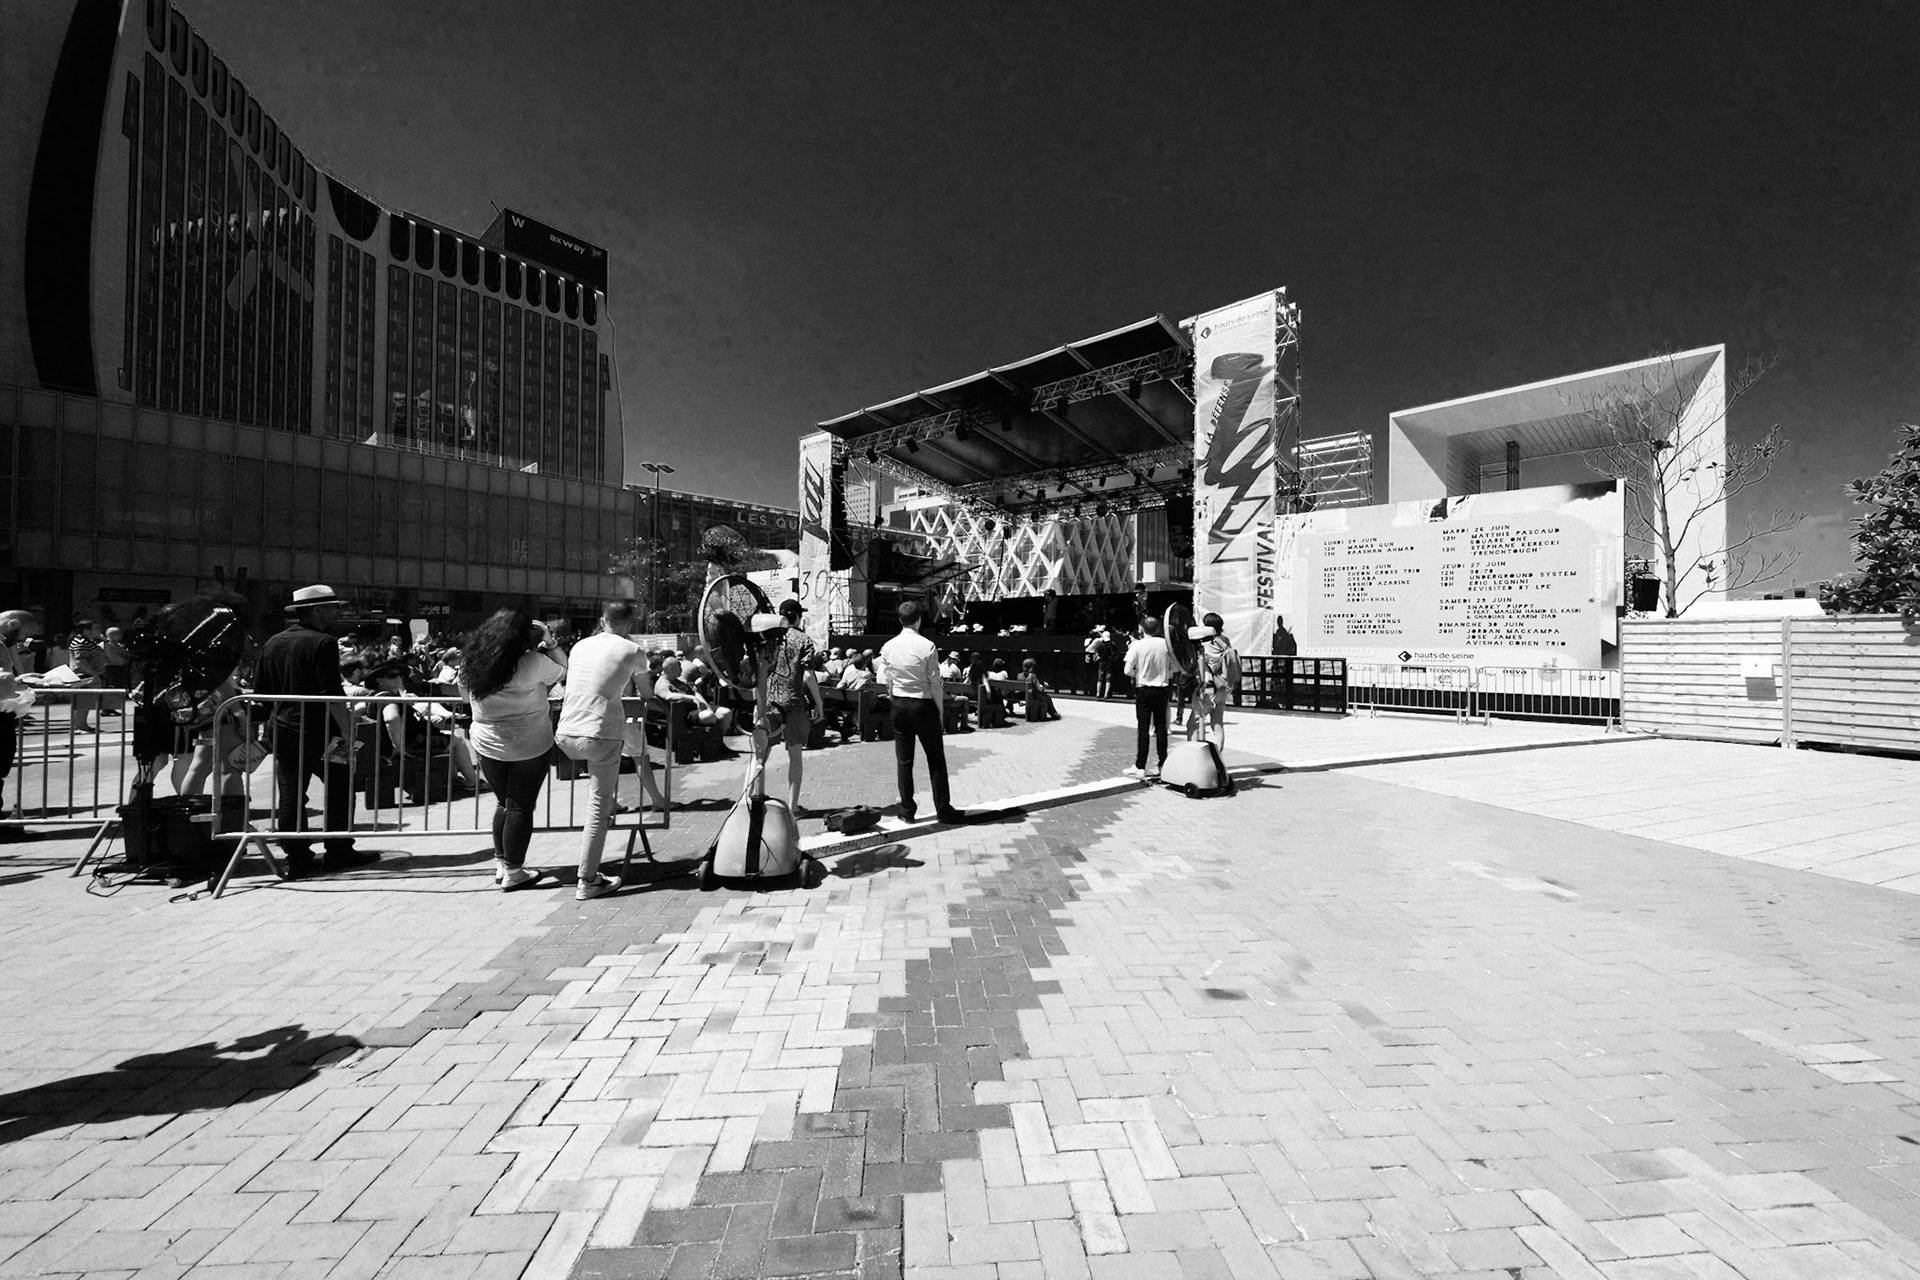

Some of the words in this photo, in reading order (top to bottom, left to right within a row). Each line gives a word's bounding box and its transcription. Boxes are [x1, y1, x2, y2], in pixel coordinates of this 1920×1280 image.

[511, 215, 525, 229] W
[549, 233, 586, 255] axway
[736, 510, 767, 526] LES
[1256, 521, 1275, 610] FESTIVAL
